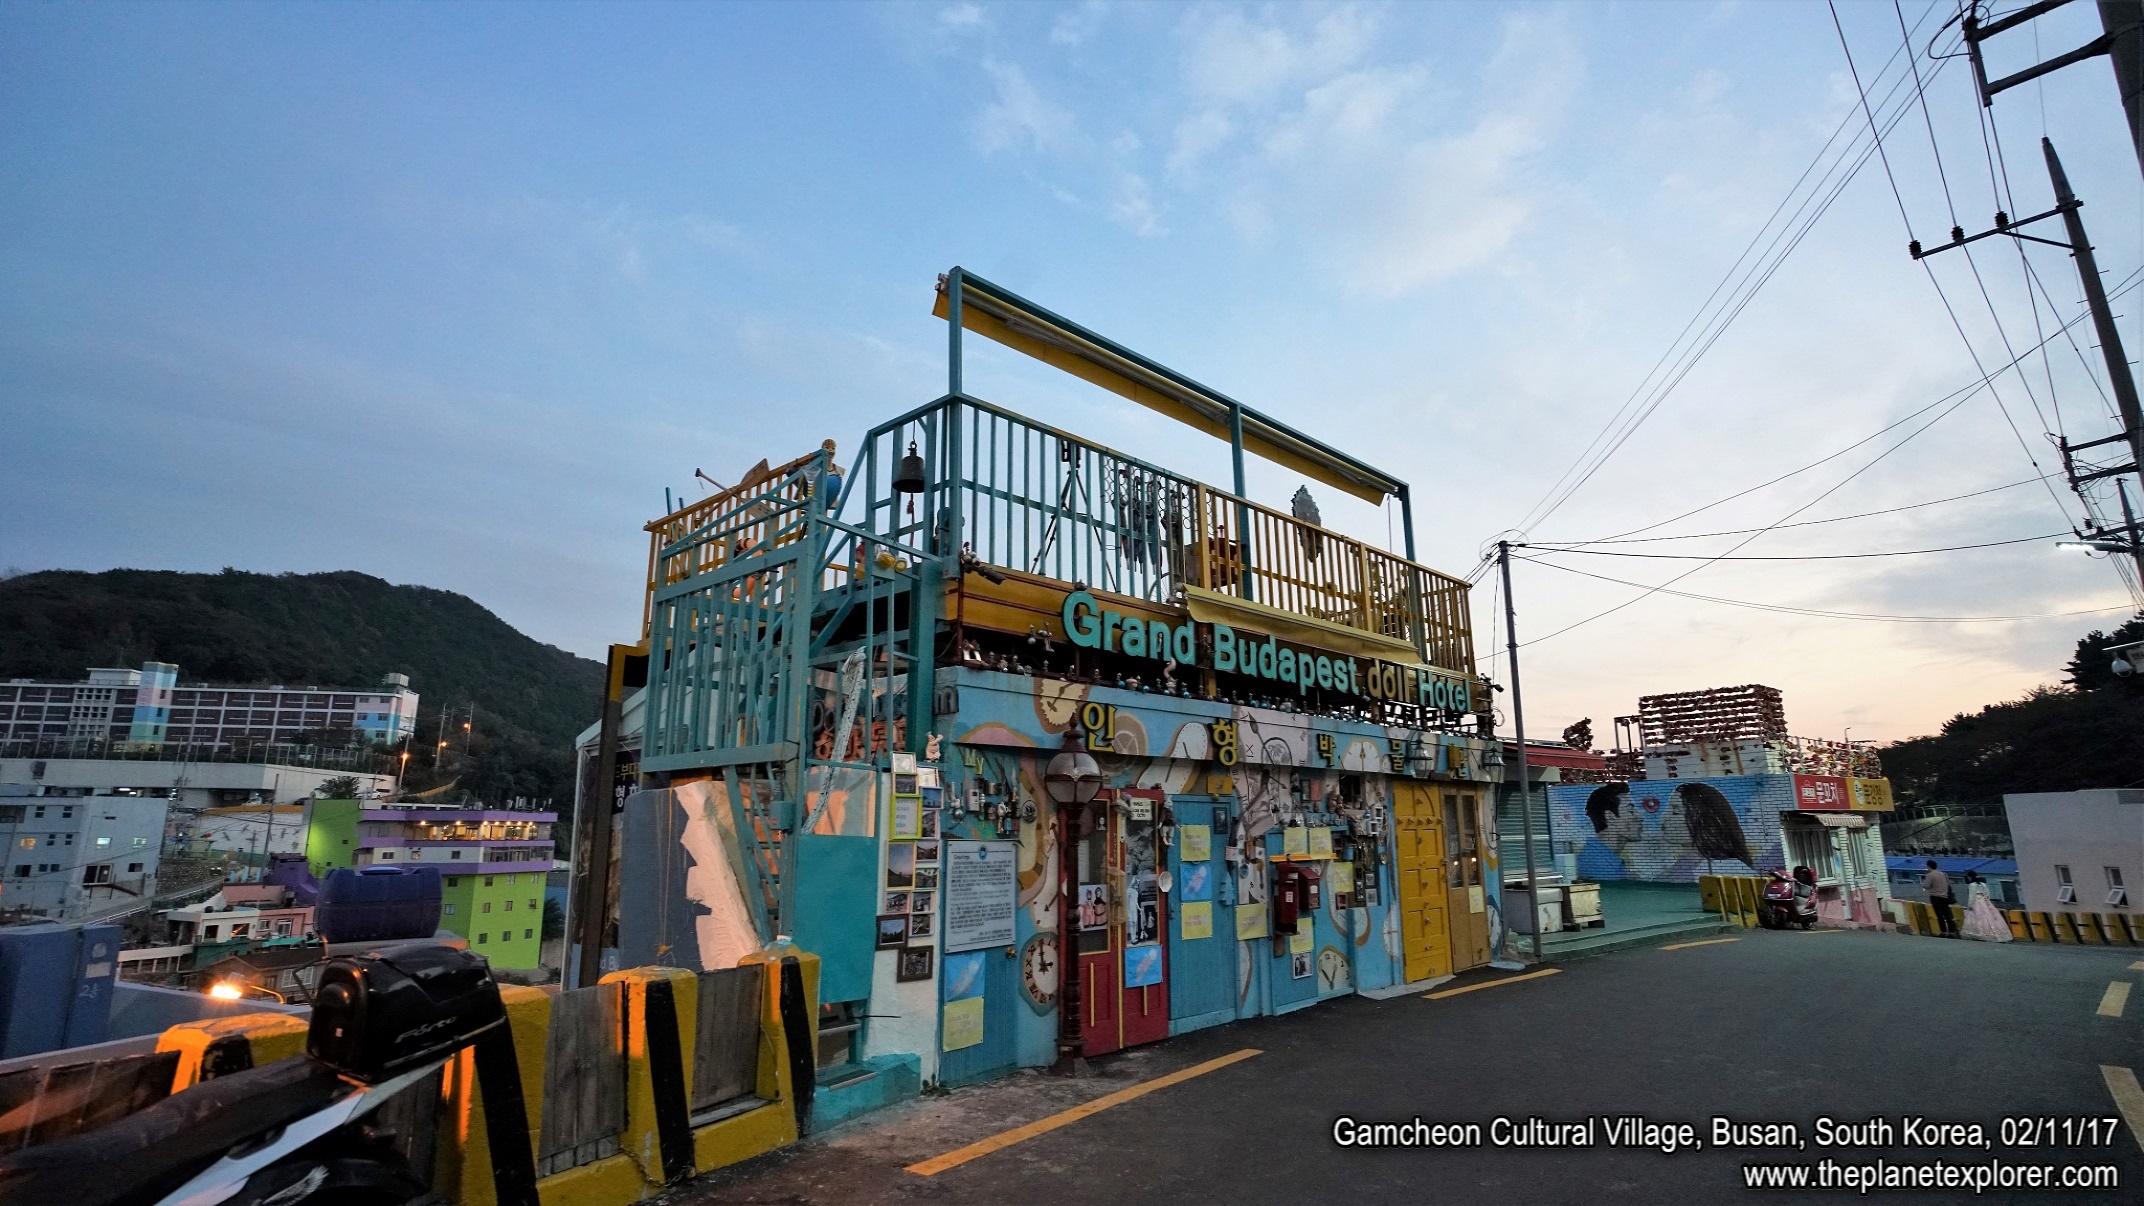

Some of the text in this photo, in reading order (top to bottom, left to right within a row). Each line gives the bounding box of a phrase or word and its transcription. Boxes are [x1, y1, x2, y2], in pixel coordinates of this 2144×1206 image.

[1063, 590, 1472, 714] Grand Budapest doll Hotel
[1082, 701, 1118, 754] 인
[1212, 718, 1240, 767] 형
